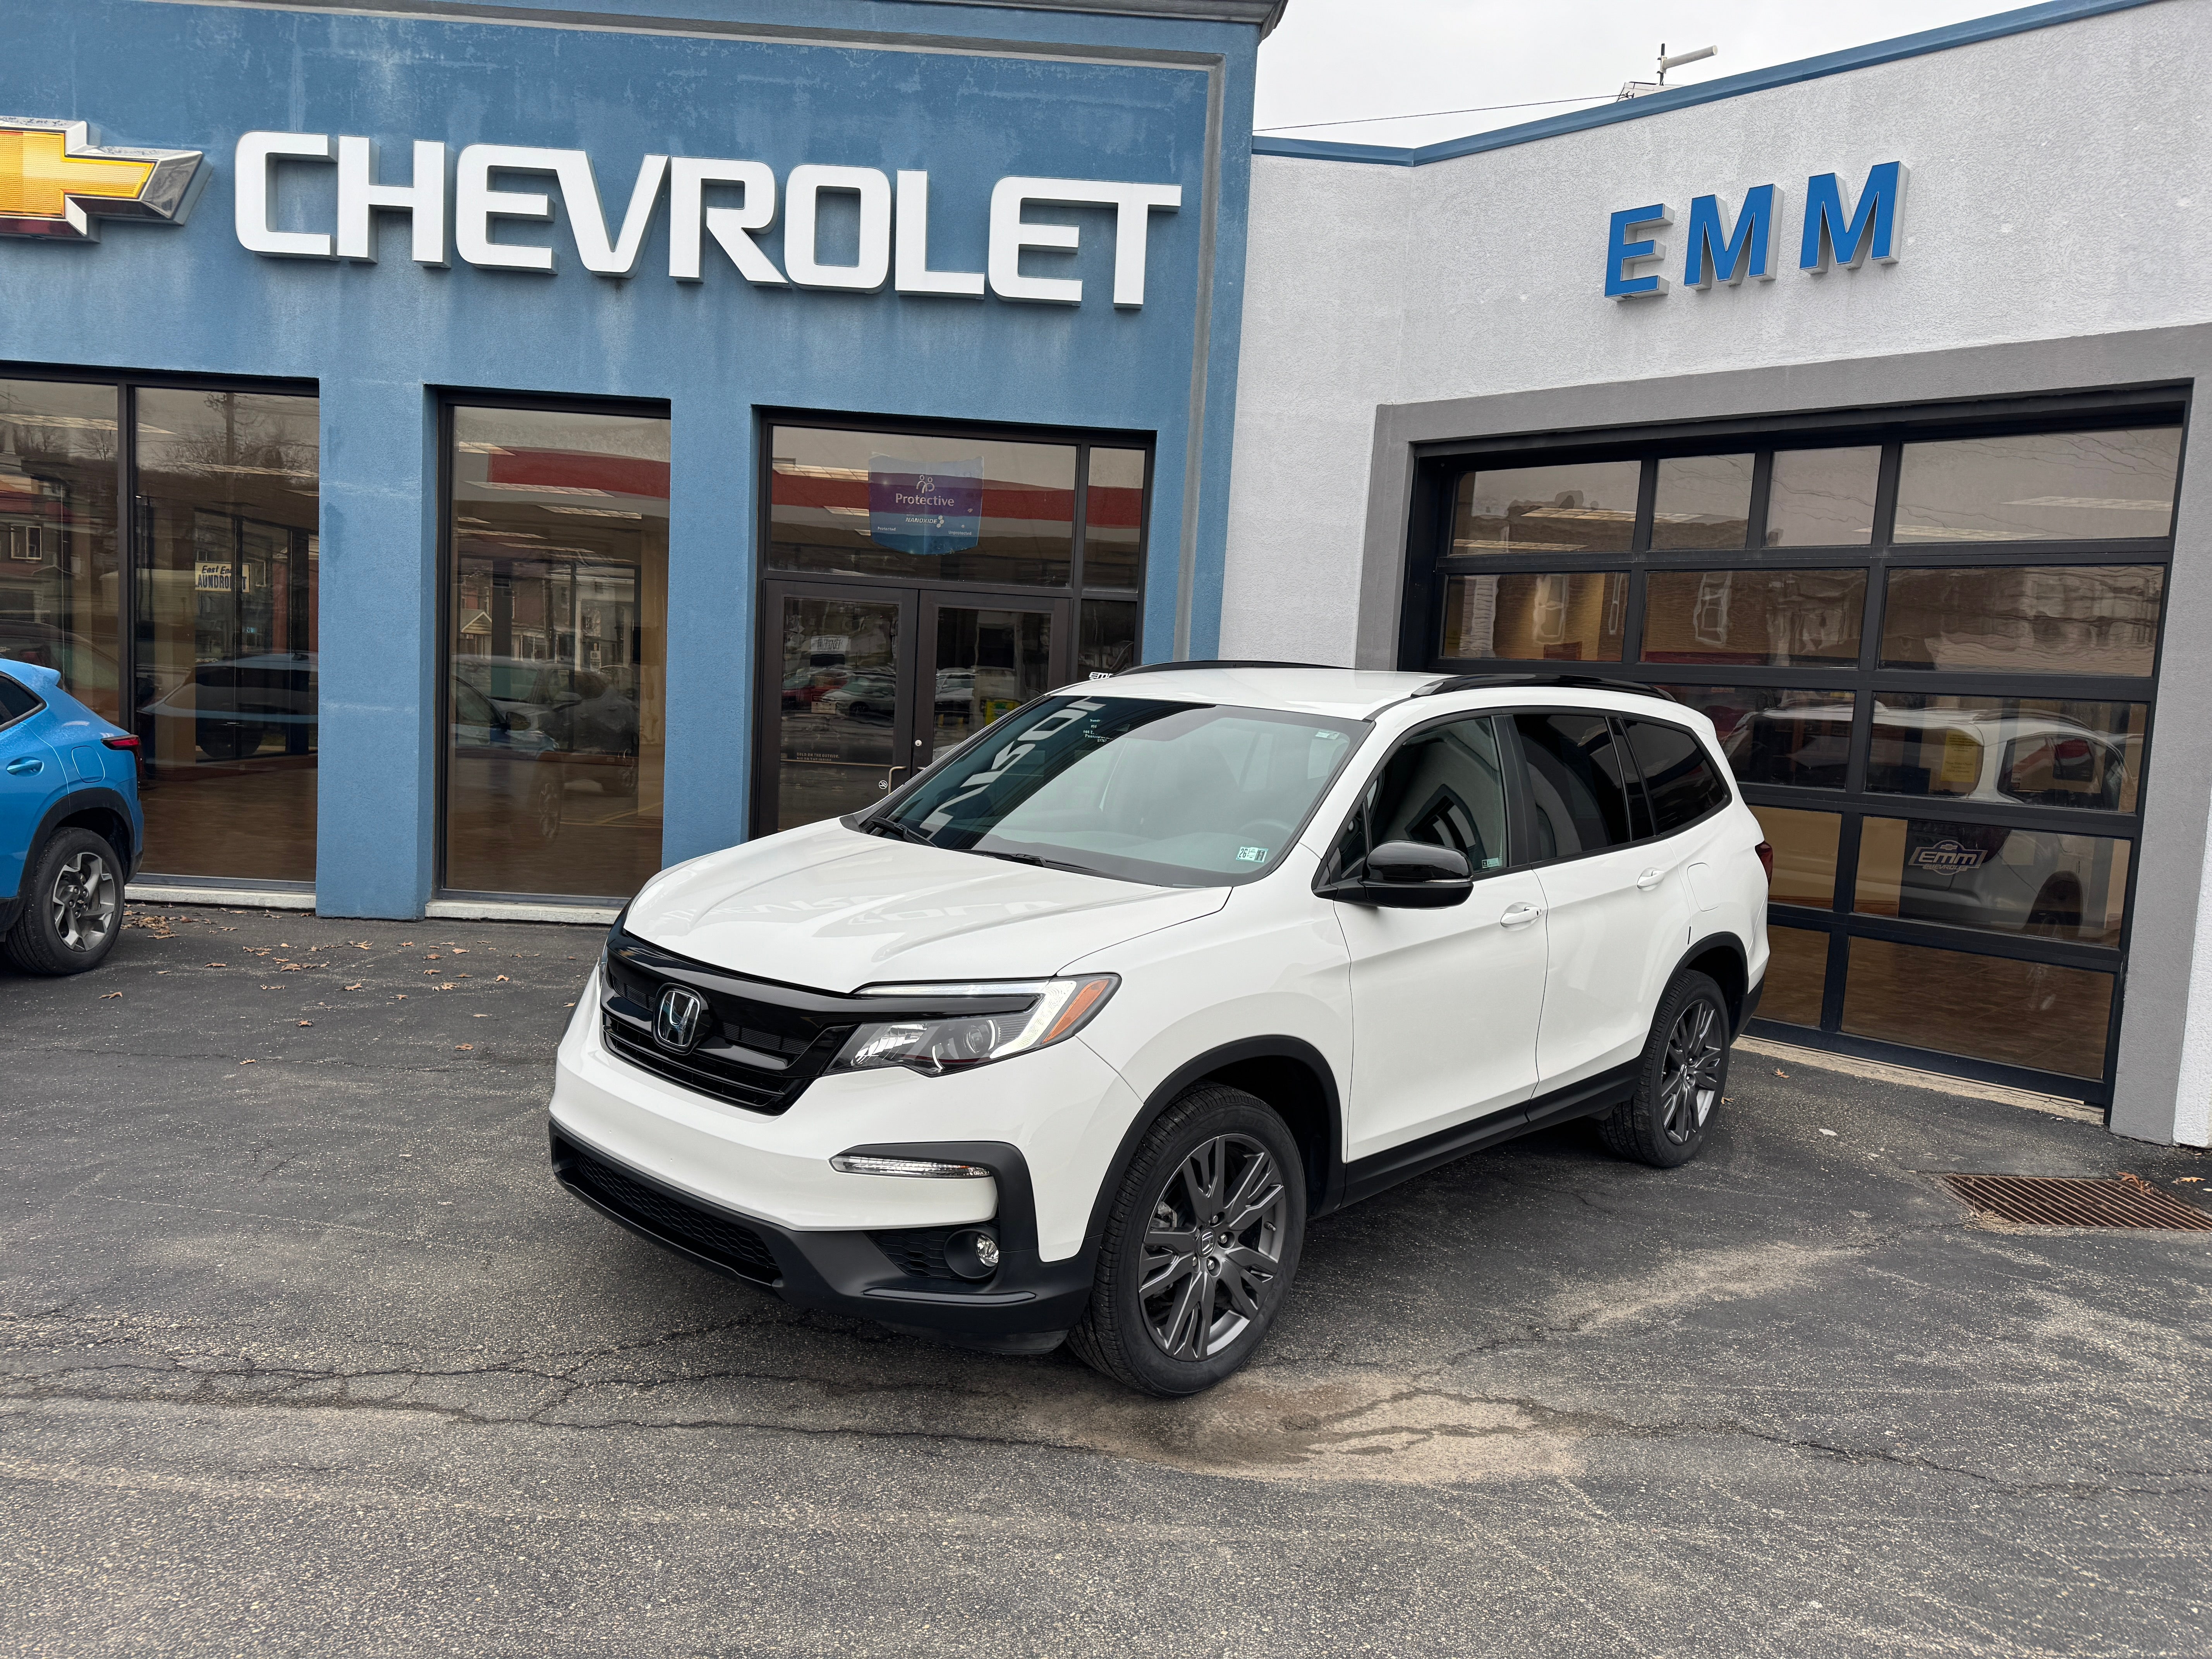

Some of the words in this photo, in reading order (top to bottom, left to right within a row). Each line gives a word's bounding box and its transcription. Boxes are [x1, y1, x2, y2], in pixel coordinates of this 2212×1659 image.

[234, 131, 1182, 309] CHEVROLET
[1604, 161, 1910, 302] EMM
[895, 493, 955, 506] Protective
[201, 565, 219, 574] East
[1239, 848, 1248, 858] 26
